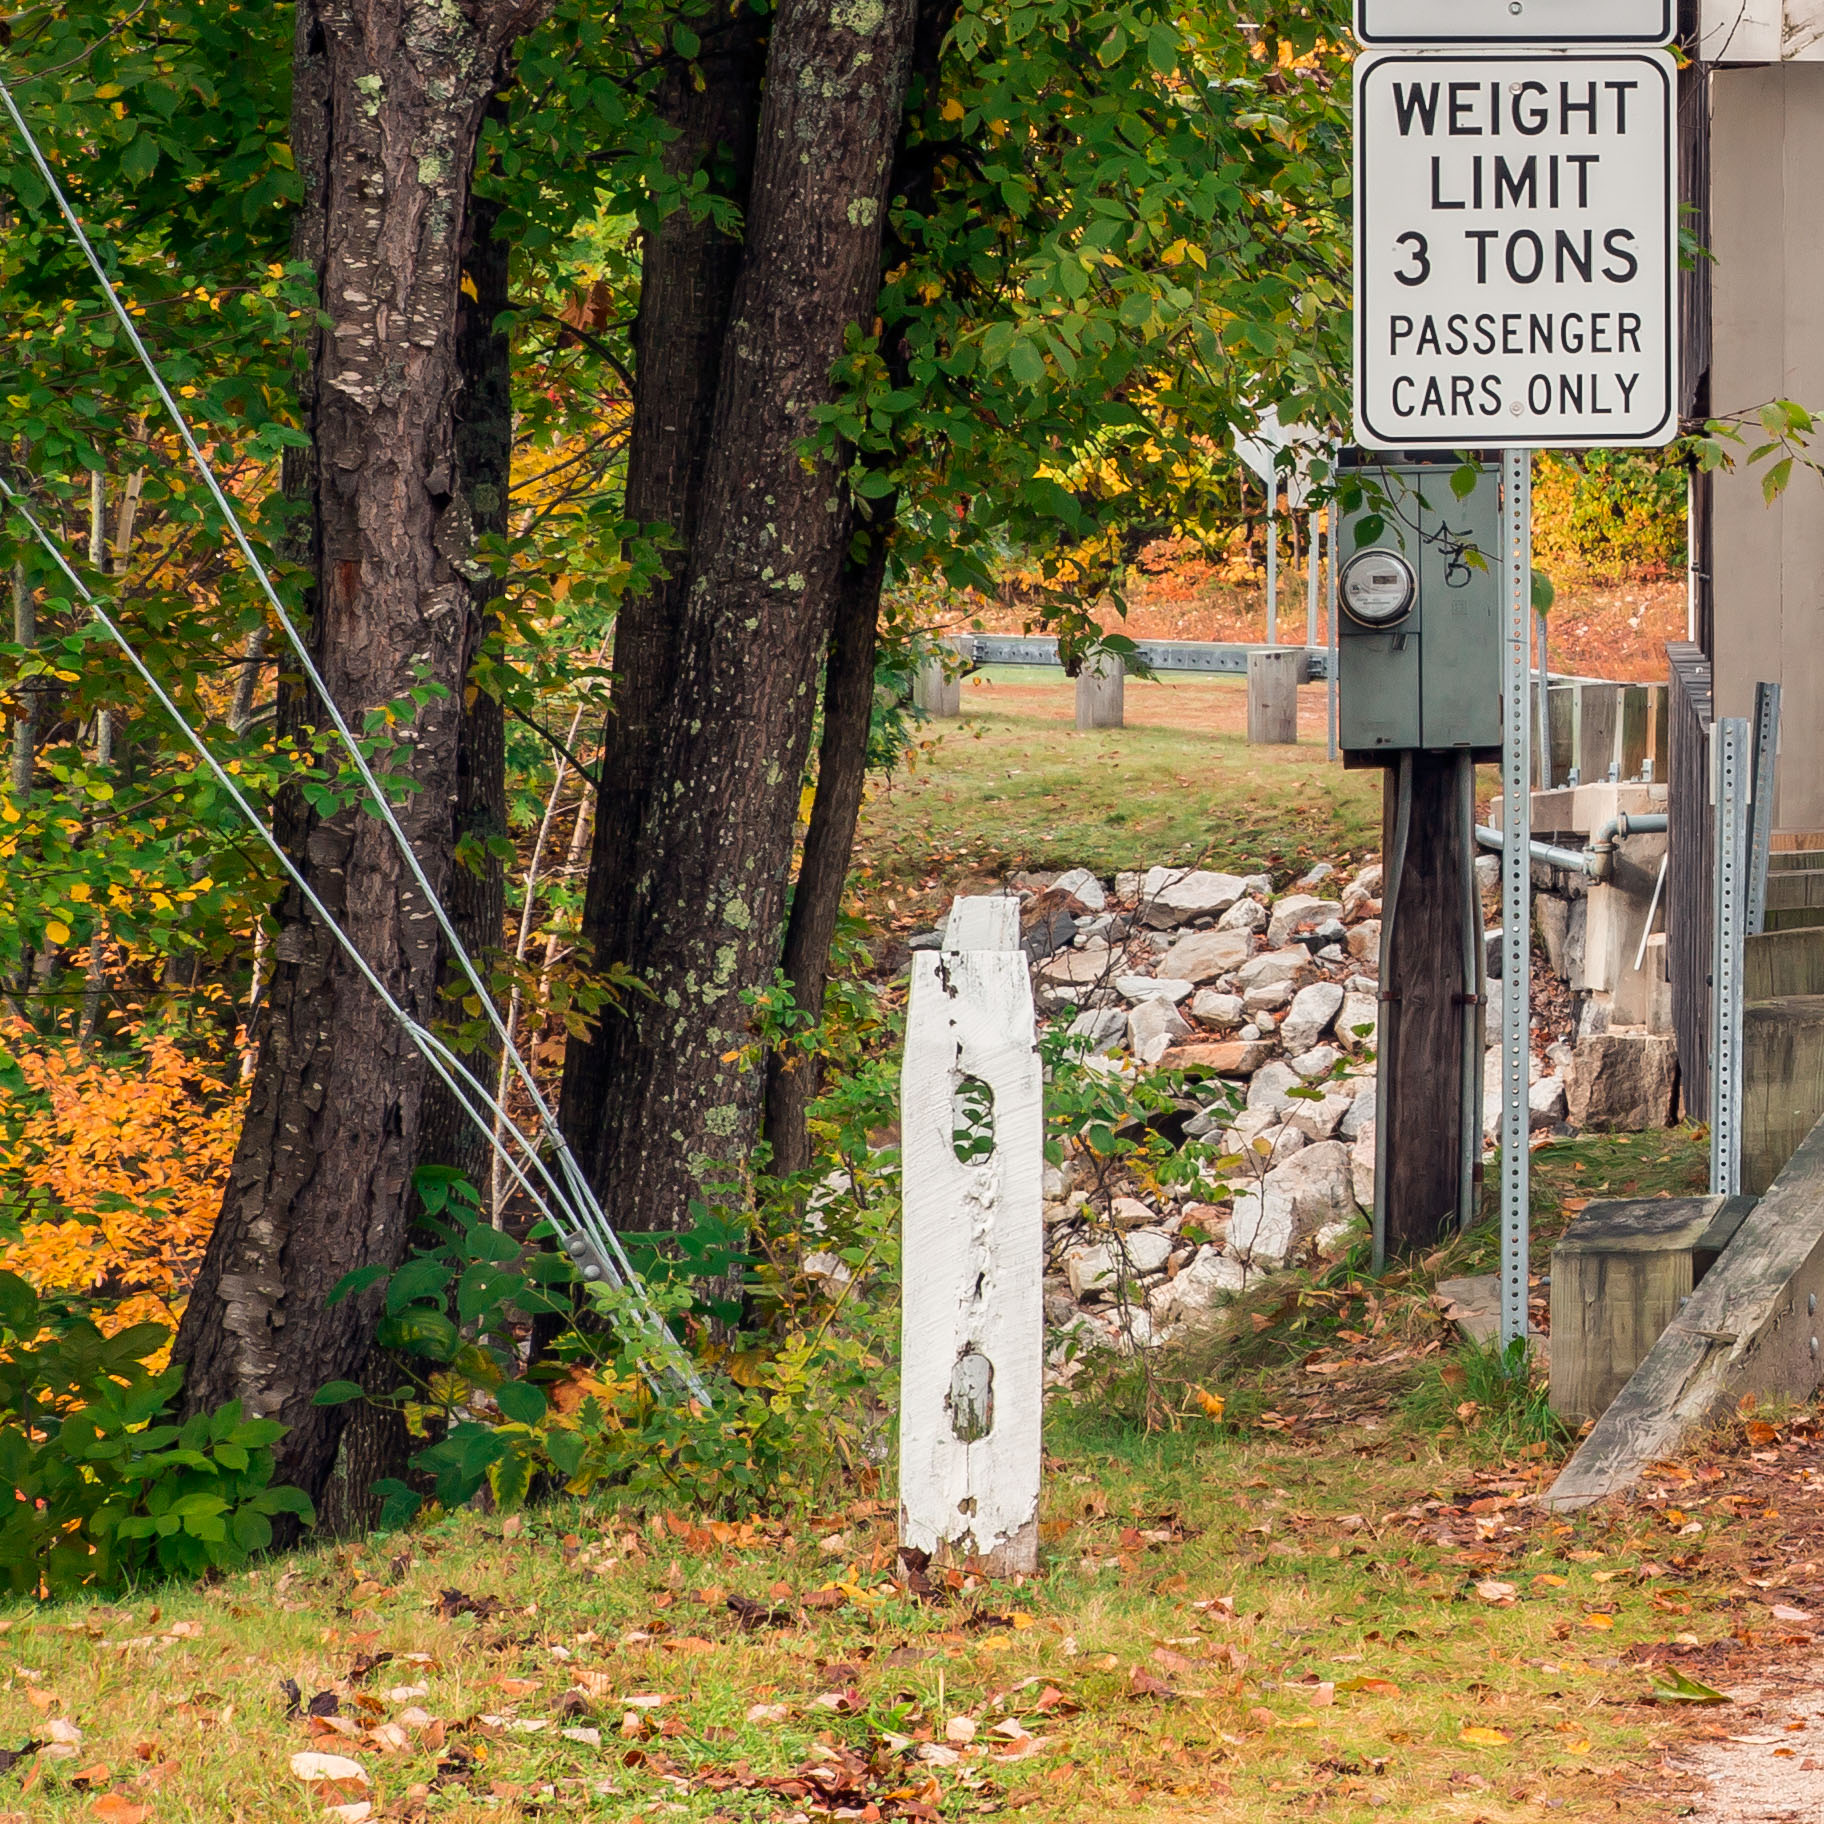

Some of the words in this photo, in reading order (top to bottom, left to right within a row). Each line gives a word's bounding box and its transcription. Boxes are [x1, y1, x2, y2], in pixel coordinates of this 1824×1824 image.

[1392, 80, 1638, 137] WEIGHT
[1431, 154, 1600, 210] LIMIT
[1393, 230, 1431, 287] 3
[1464, 228, 1638, 285] TONS
[1390, 312, 1641, 356] PASSENGER
[1392, 374, 1502, 418] CARS
[1528, 373, 1640, 417] ONLY
